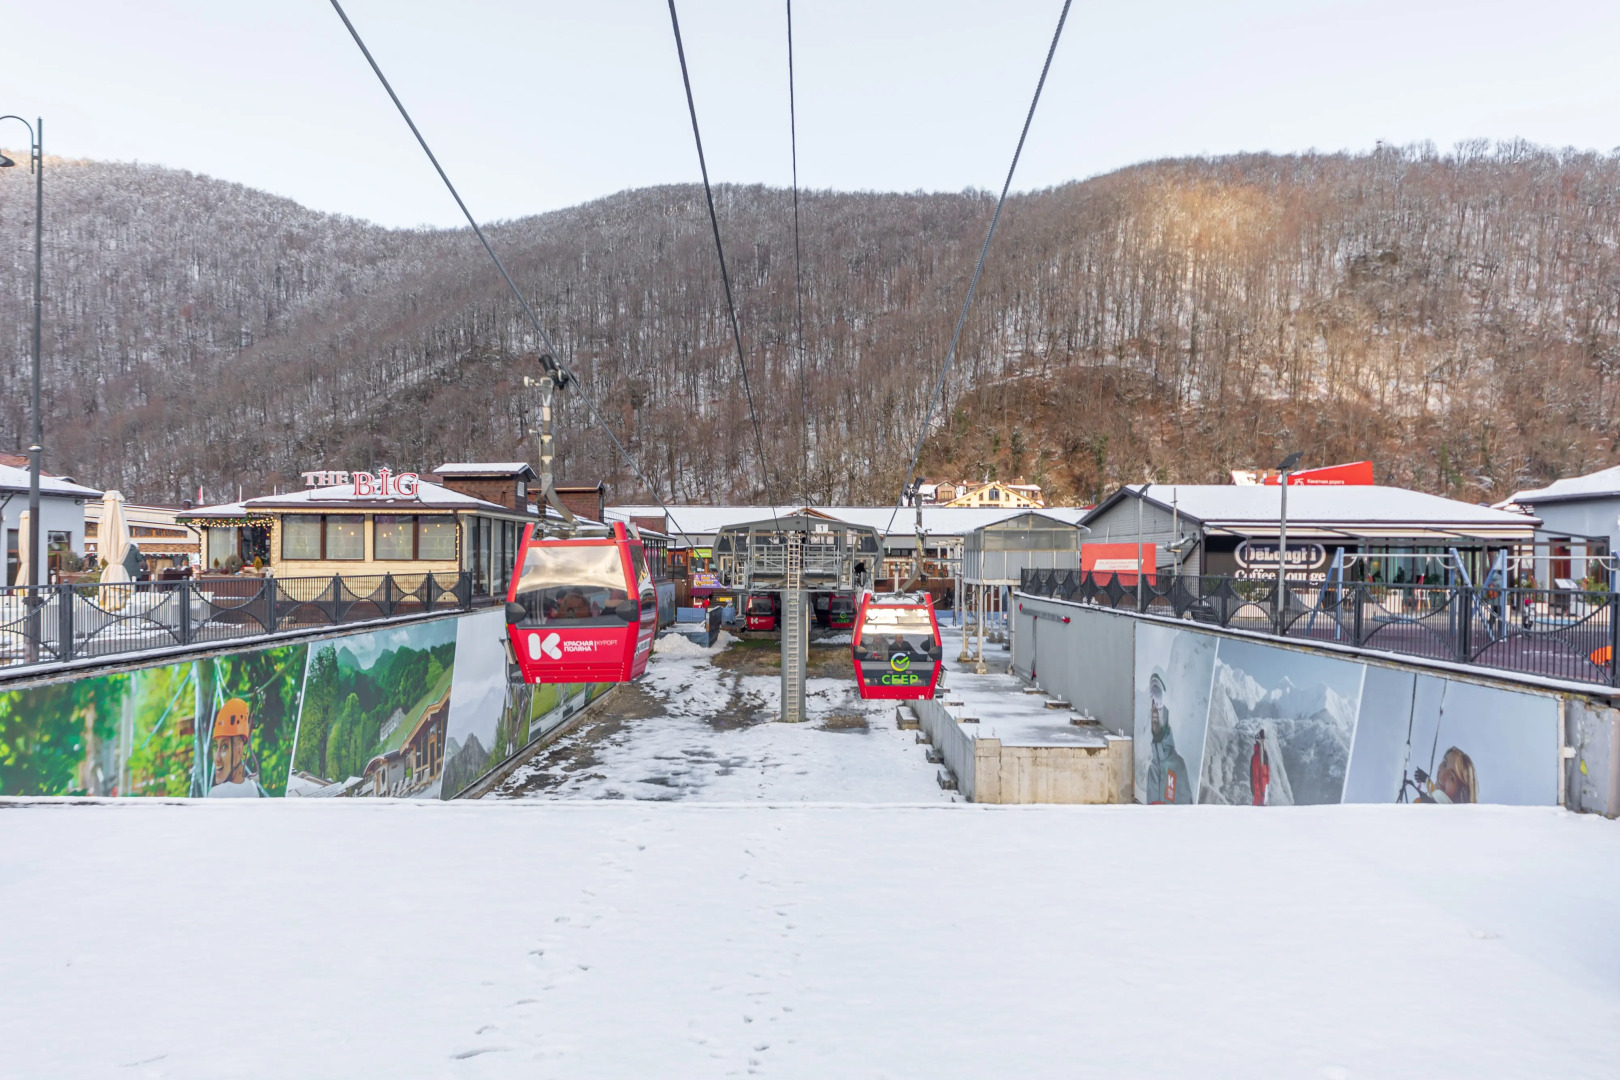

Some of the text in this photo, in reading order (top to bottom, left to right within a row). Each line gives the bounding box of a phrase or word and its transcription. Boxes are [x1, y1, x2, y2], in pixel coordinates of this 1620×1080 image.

[301, 467, 419, 496] THE BIG
[881, 674, 919, 685] СБЕР
